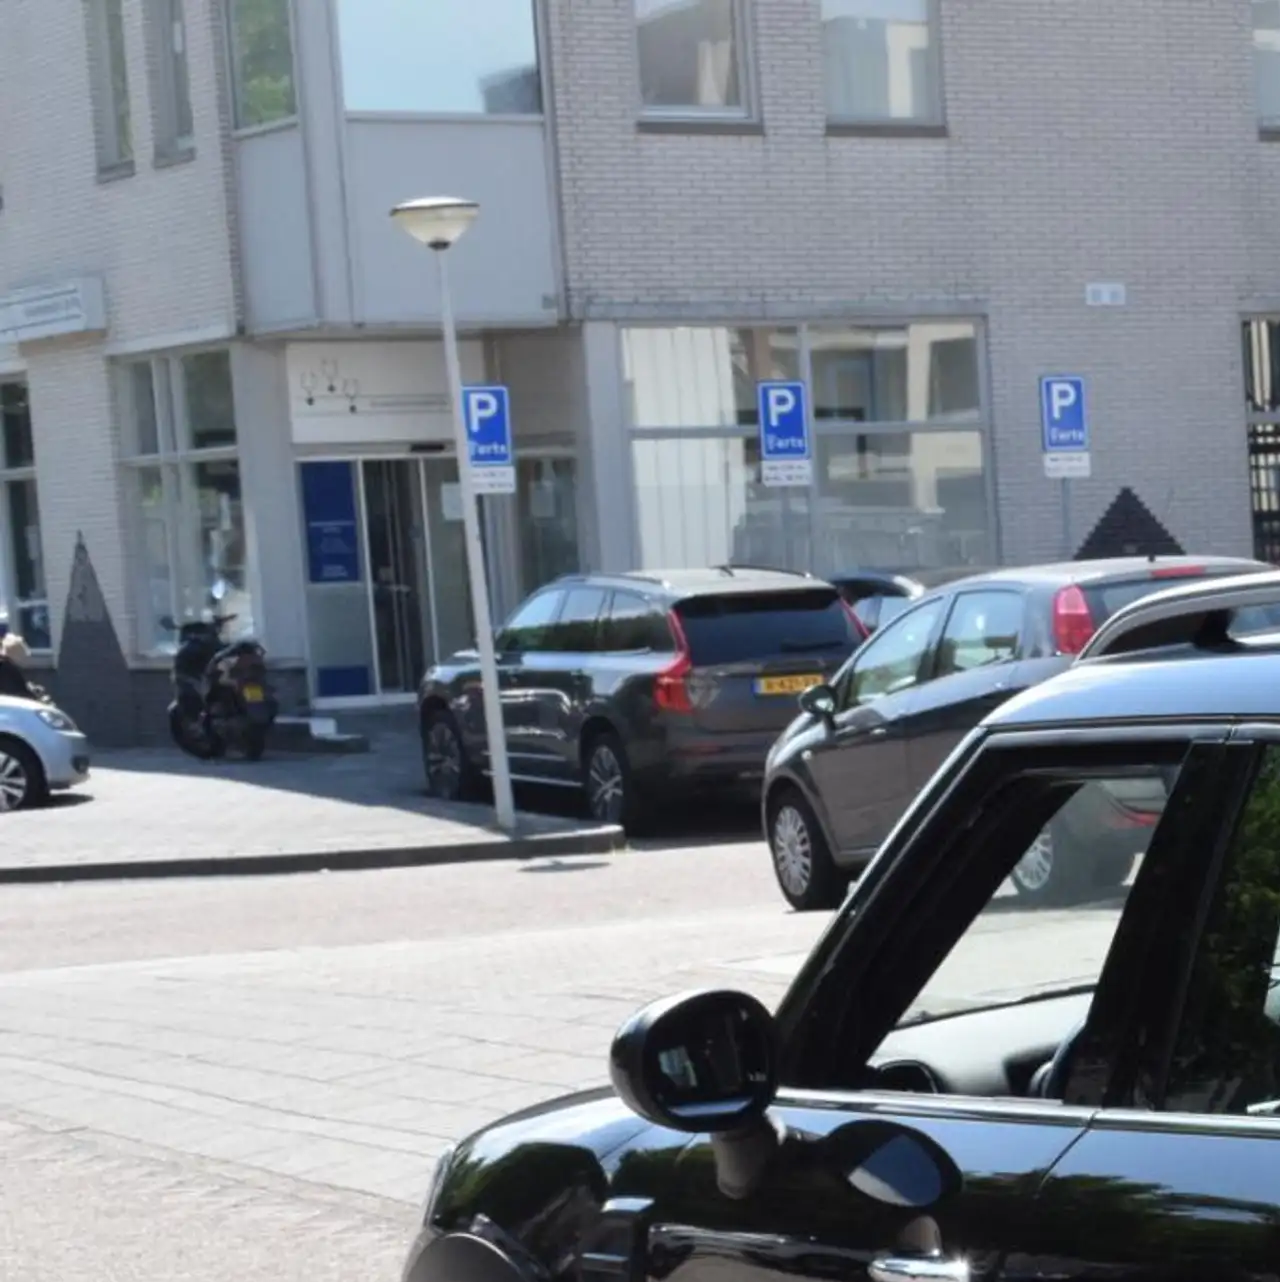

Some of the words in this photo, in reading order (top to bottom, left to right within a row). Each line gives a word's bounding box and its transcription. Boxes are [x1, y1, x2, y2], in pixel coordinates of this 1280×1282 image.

[469, 392, 498, 432] P
[769, 388, 796, 427] P
[1051, 383, 1076, 419] P
